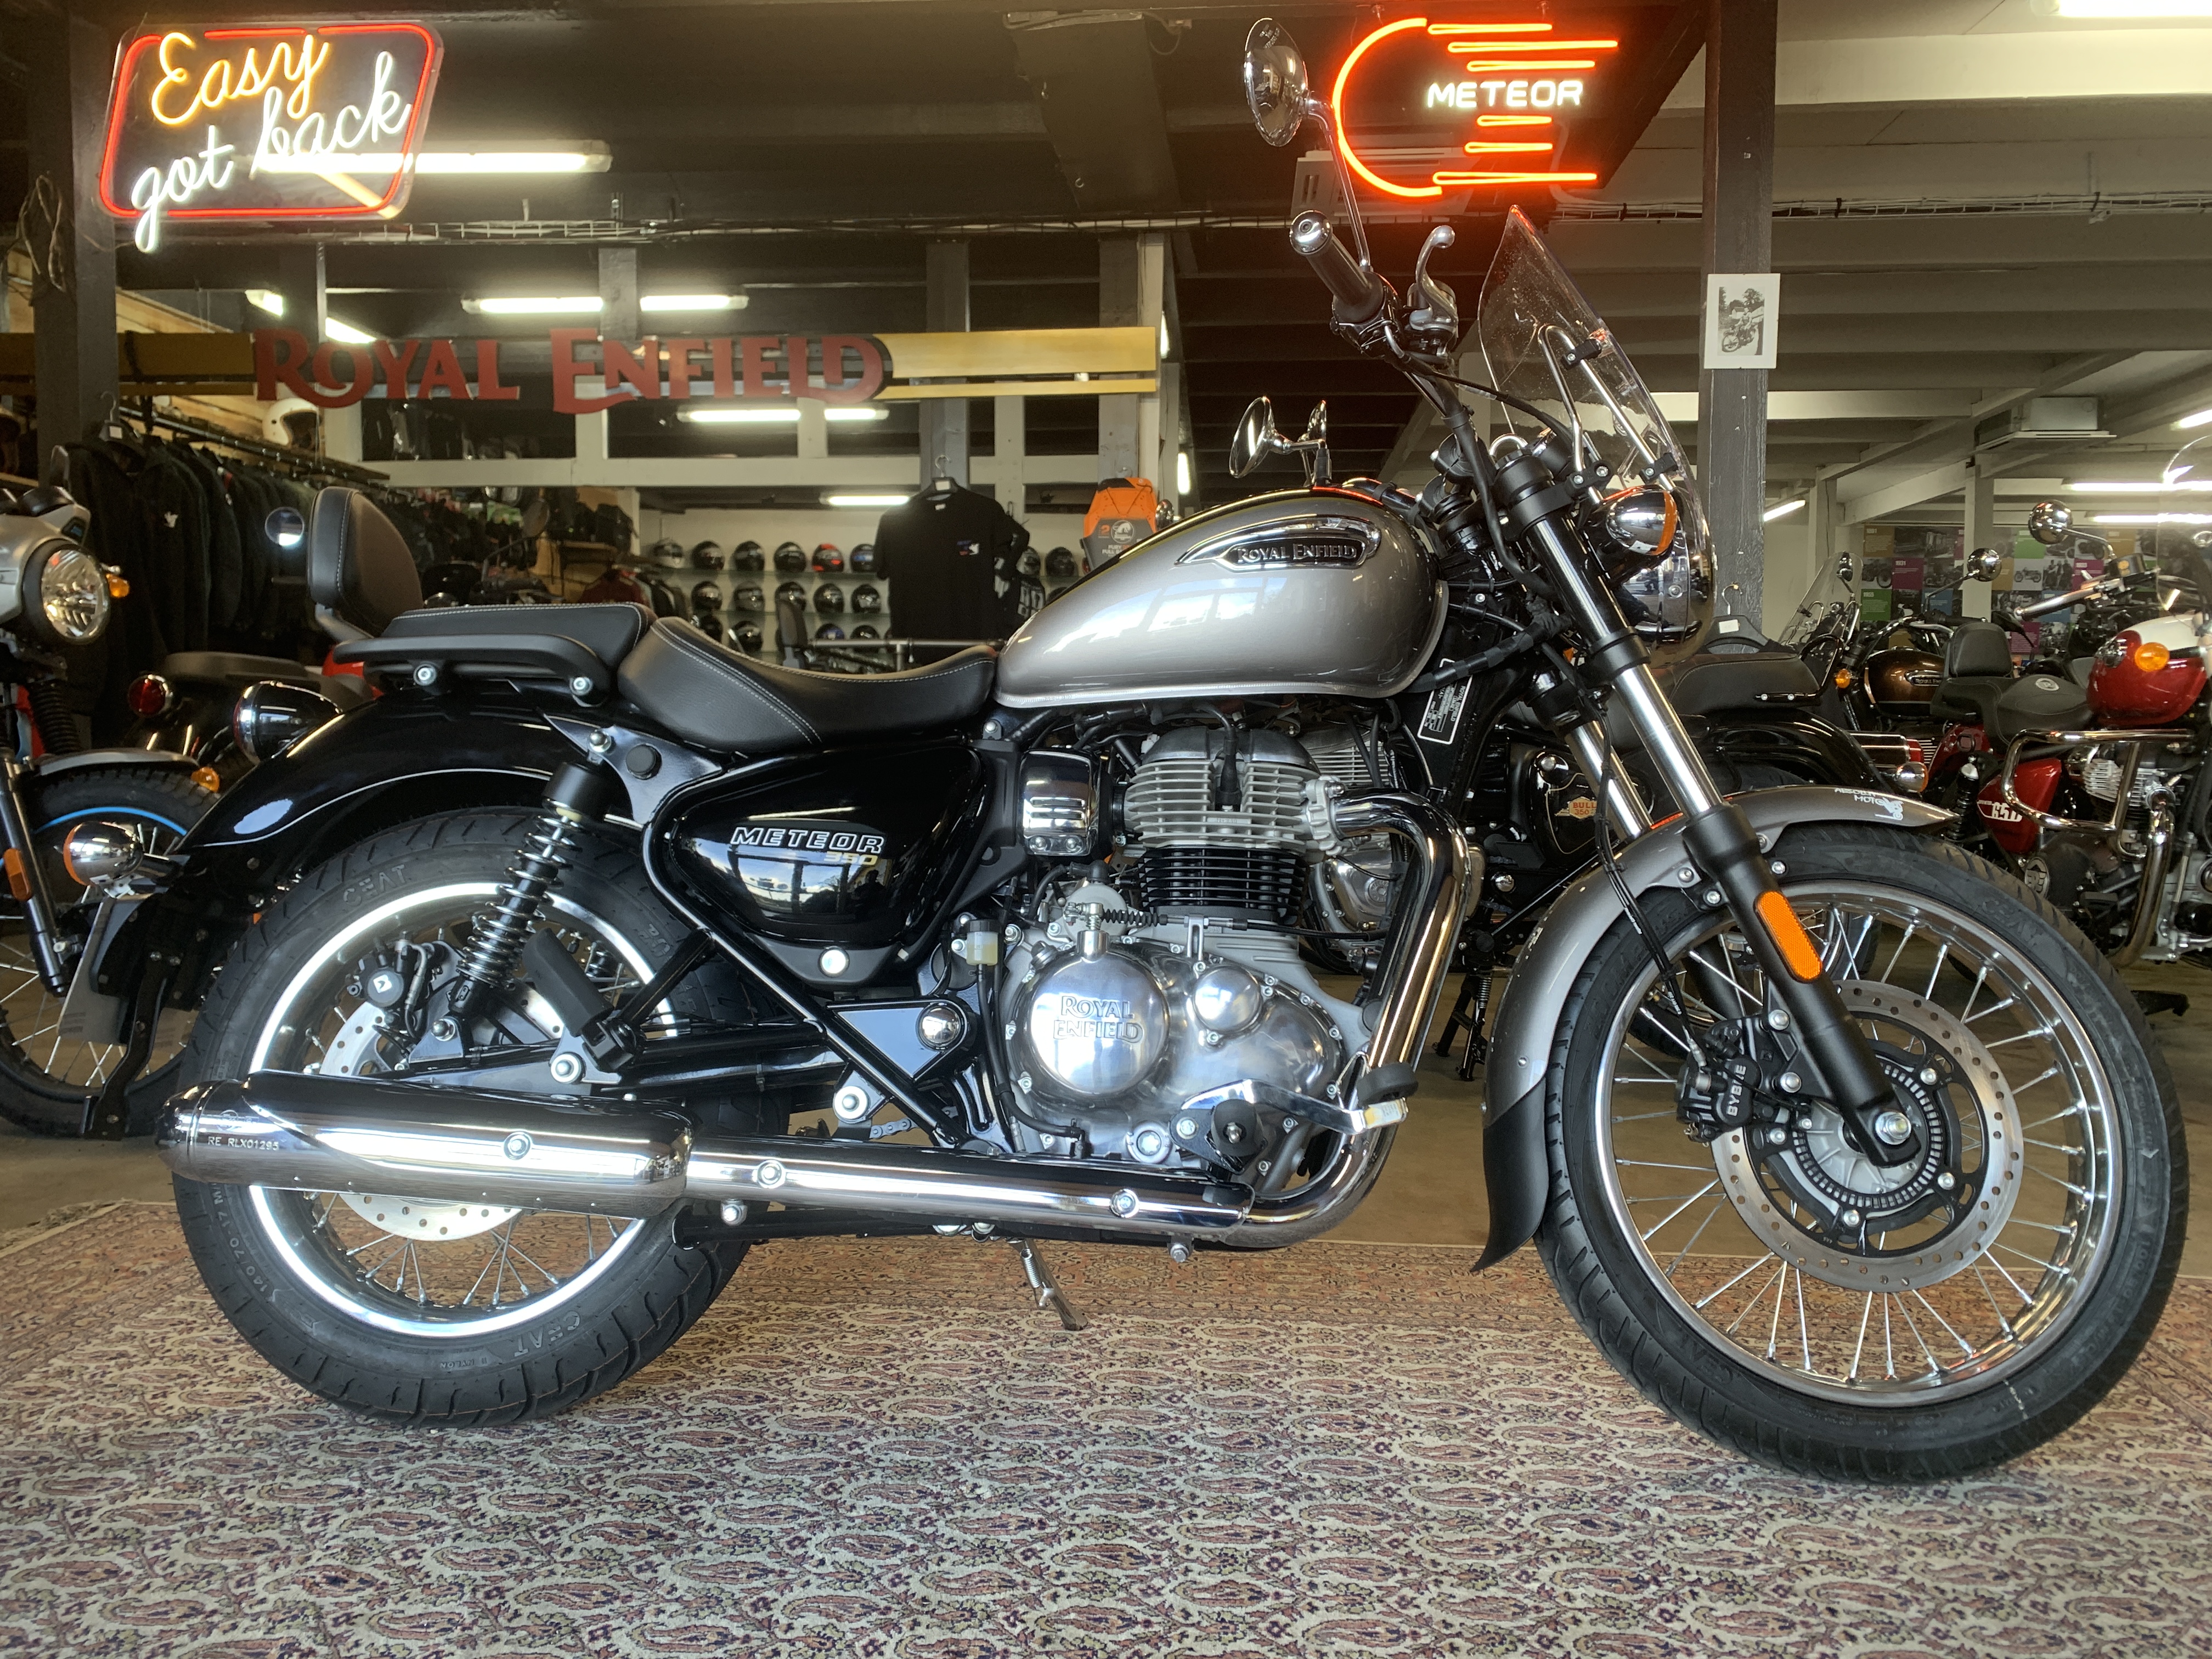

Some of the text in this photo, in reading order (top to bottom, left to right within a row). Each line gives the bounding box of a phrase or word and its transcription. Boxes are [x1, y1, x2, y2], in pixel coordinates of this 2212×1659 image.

[150, 31, 331, 127] Easy
[1427, 81, 1583, 108] METEOR
[130, 50, 412, 253] got back
[254, 328, 884, 414] ROYAL ENFIELD
[1237, 543, 1357, 564] ROYAL ENFIELD
[730, 827, 885, 854] METEOR
[823, 850, 879, 866] 350
[342, 864, 407, 907] CEAT
[1061, 996, 1135, 1019] ROYAL
[1053, 1019, 1143, 1043] ENFIELD
[207, 1136, 222, 1147] RE
[513, 1310, 580, 1357] CEAT
